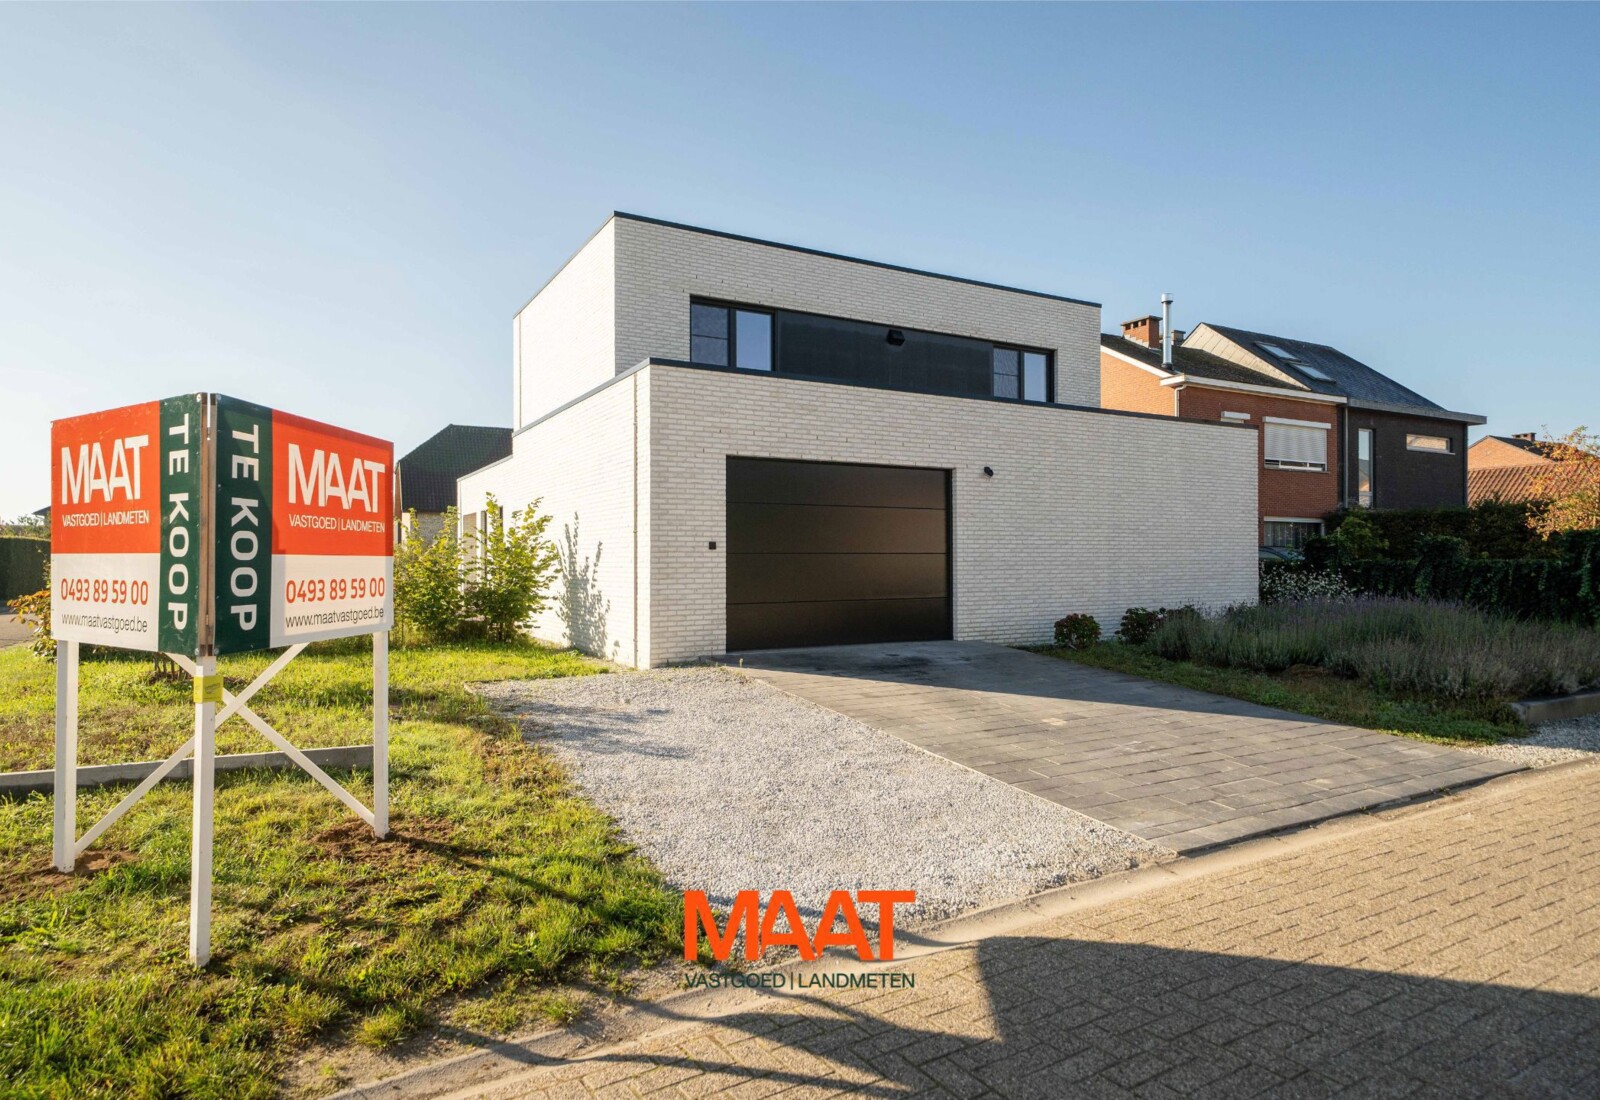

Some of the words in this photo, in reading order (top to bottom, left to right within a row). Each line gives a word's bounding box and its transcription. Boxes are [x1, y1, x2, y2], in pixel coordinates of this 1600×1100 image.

[168, 413, 189, 475] TE
[232, 424, 259, 482] TE
[61, 435, 149, 504] MAAT
[288, 443, 385, 513] MAAT
[62, 512, 100, 527] VASTGOED
[103, 510, 149, 526] LANDMETEN
[289, 514, 337, 530] VASTGOED
[341, 517, 385, 533] LANDMETEN
[168, 492, 189, 630] KOOP
[230, 497, 259, 630] KOOP
[61, 578, 90, 602] 0493
[93, 579, 109, 603] 89
[111, 580, 127, 604] 59
[130, 580, 148, 605] 00
[286, 579, 325, 603] 0493
[329, 578, 347, 600] 89
[350, 578, 366, 598] 59
[369, 577, 385, 597] 00
[61, 612, 148, 634] www.maatvastgoed.be
[286, 607, 384, 628] www.maatvastgoed.be
